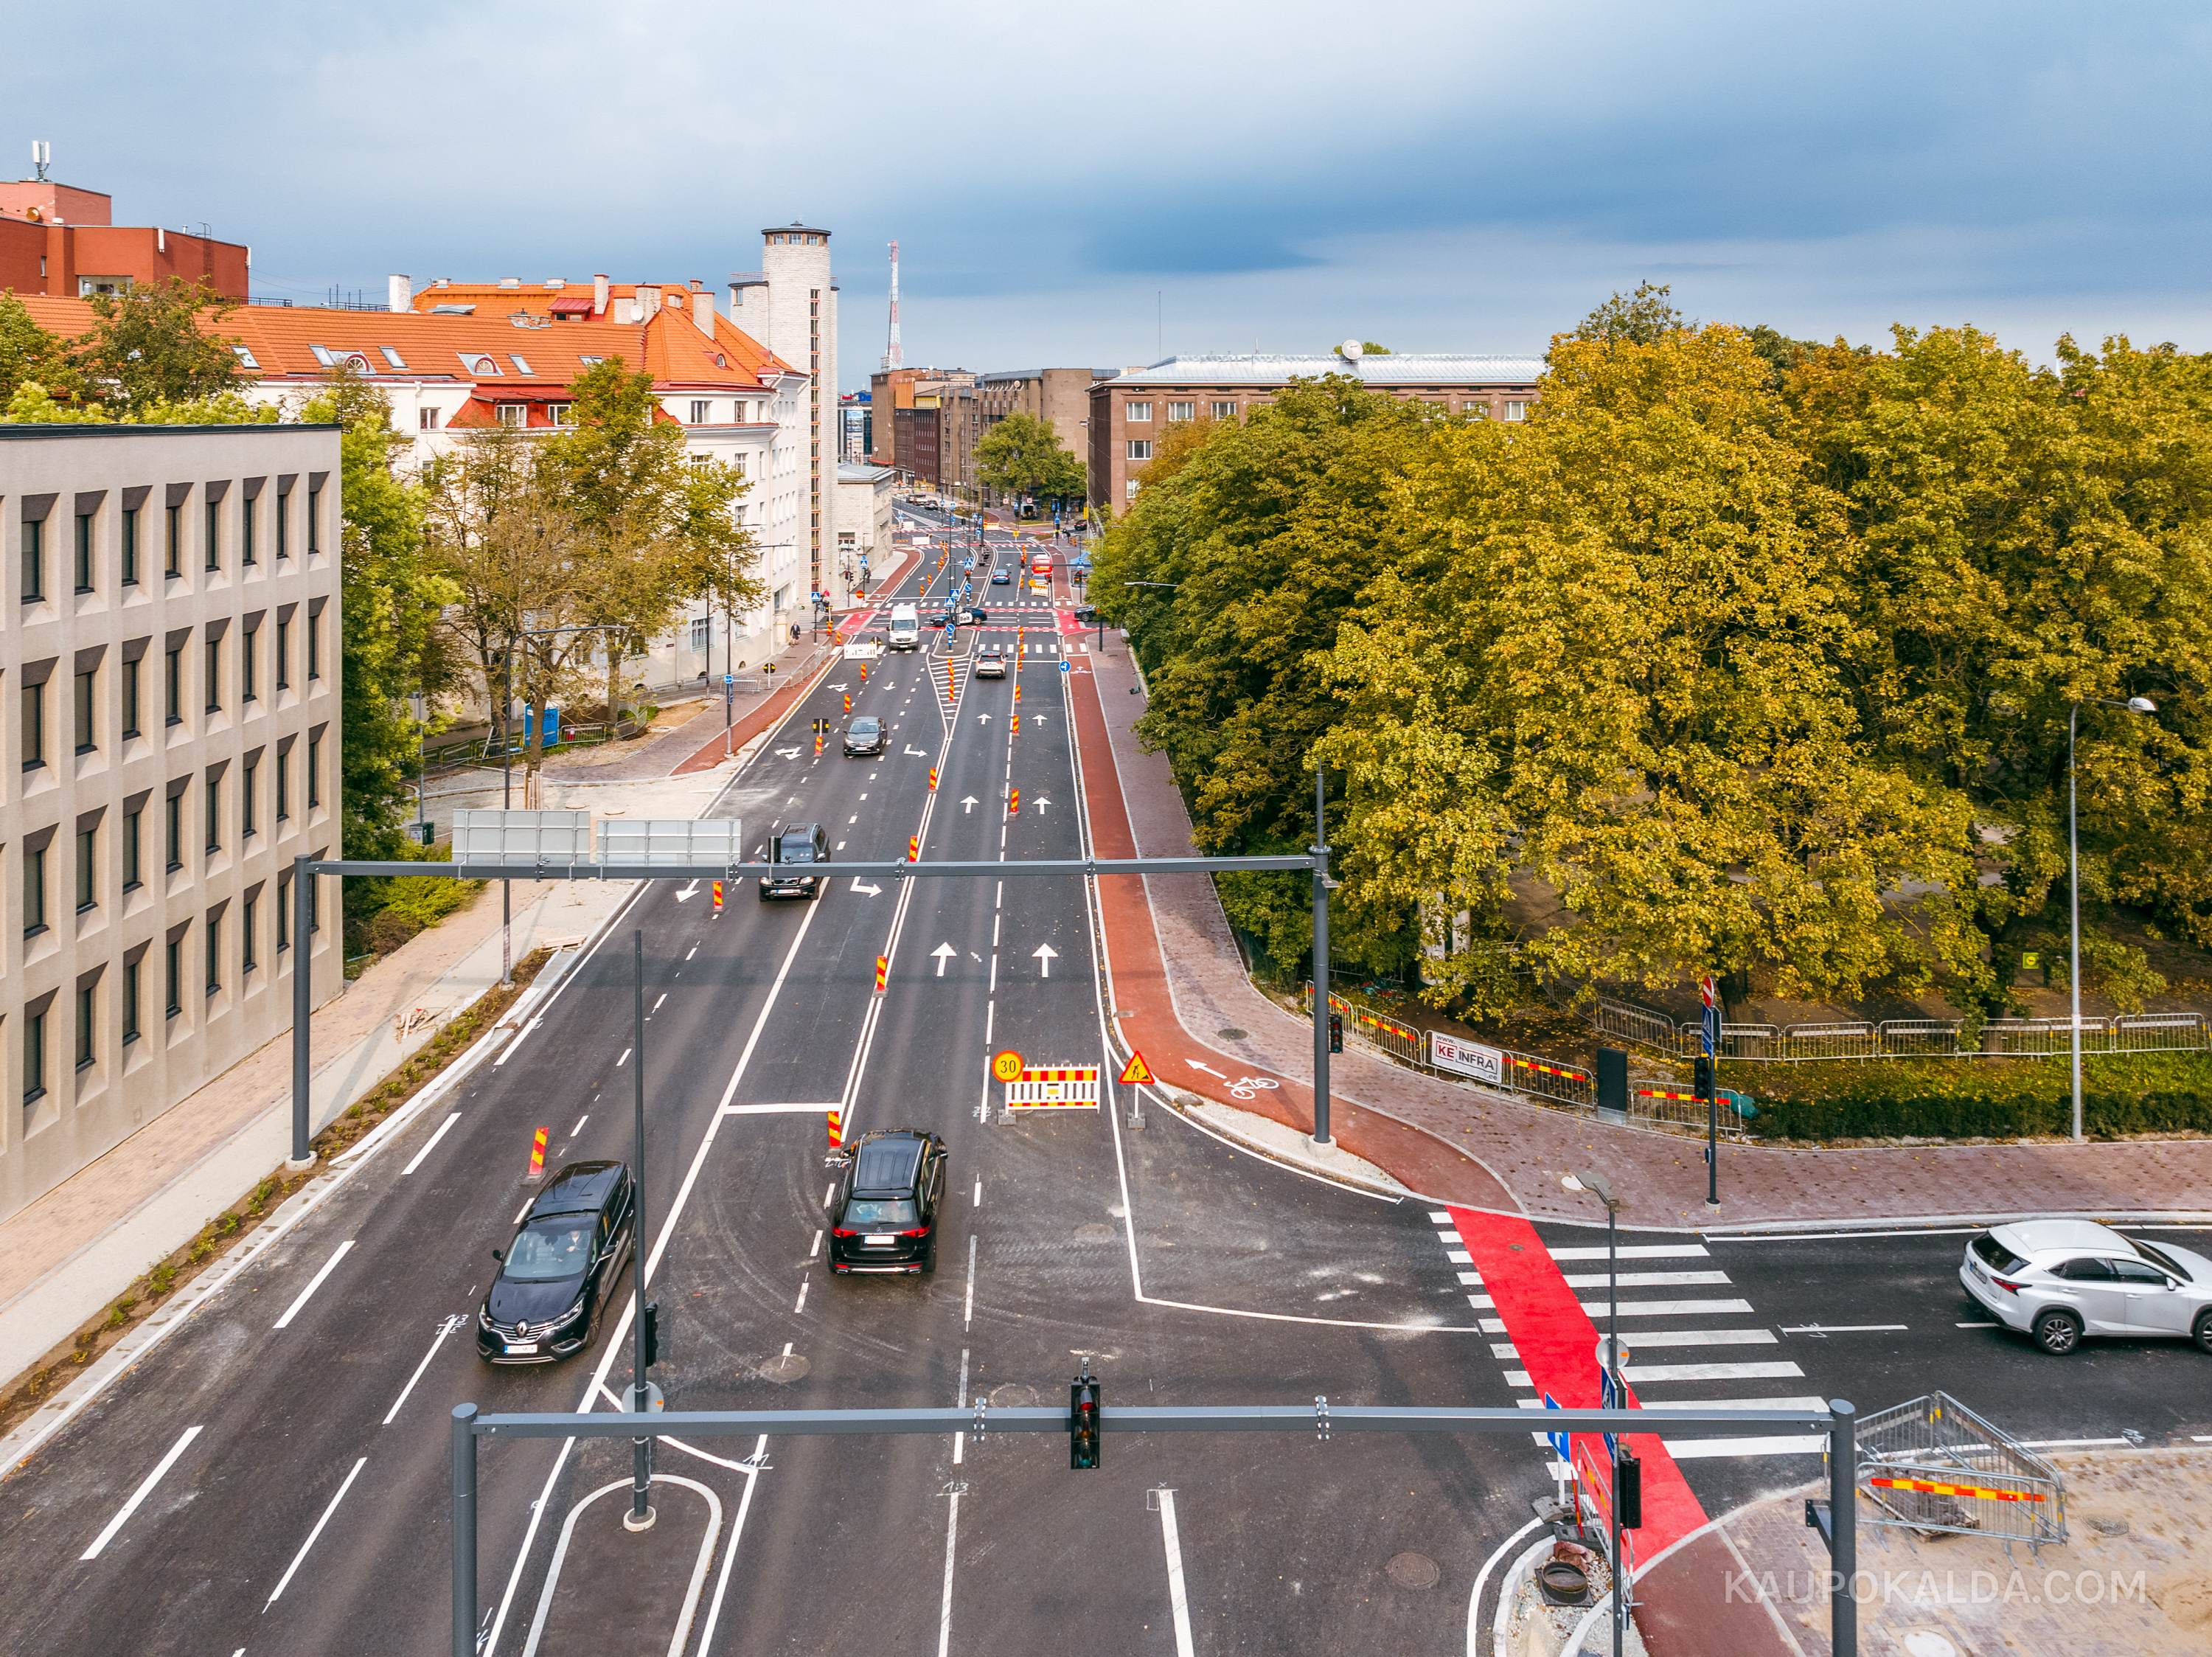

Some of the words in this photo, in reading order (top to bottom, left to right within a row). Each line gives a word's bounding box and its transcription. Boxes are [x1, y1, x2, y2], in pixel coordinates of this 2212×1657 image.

[1436, 1035, 1455, 1044] www.
[1439, 1045, 1454, 1057] KE
[1458, 1051, 1495, 1071] INFRA
[1001, 1060, 1016, 1074] 30
